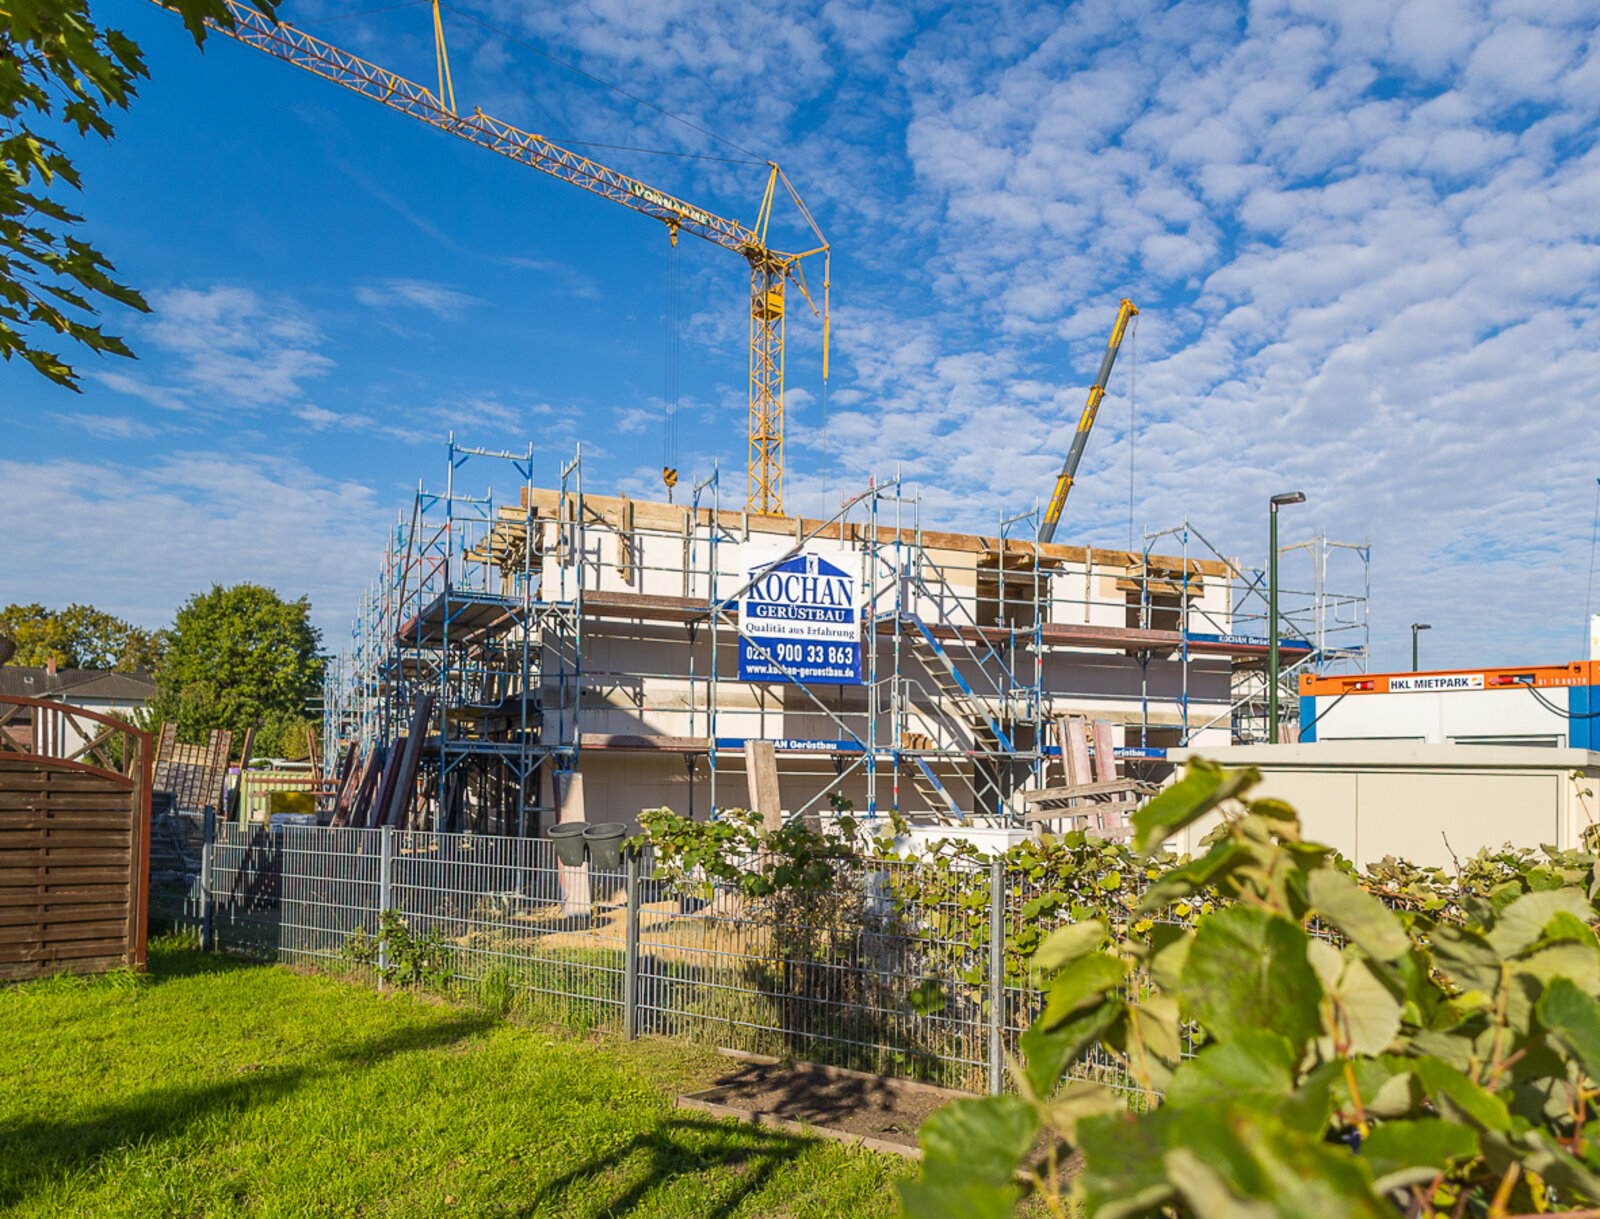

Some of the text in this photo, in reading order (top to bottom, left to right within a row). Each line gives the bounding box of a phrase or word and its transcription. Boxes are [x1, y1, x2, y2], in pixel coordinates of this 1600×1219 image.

[748, 571, 855, 607] KOCHAN
[756, 604, 845, 622] GERÜSTBAU
[745, 622, 855, 639] Qualität aus Erfahrung
[777, 643, 802, 662] 900
[807, 645, 824, 663] 33
[828, 646, 853, 665] 863
[1391, 677, 1469, 690] HKL MIETPARK
[789, 740, 837, 750] Gerüstbau
[1113, 748, 1146, 757] erüstbau
